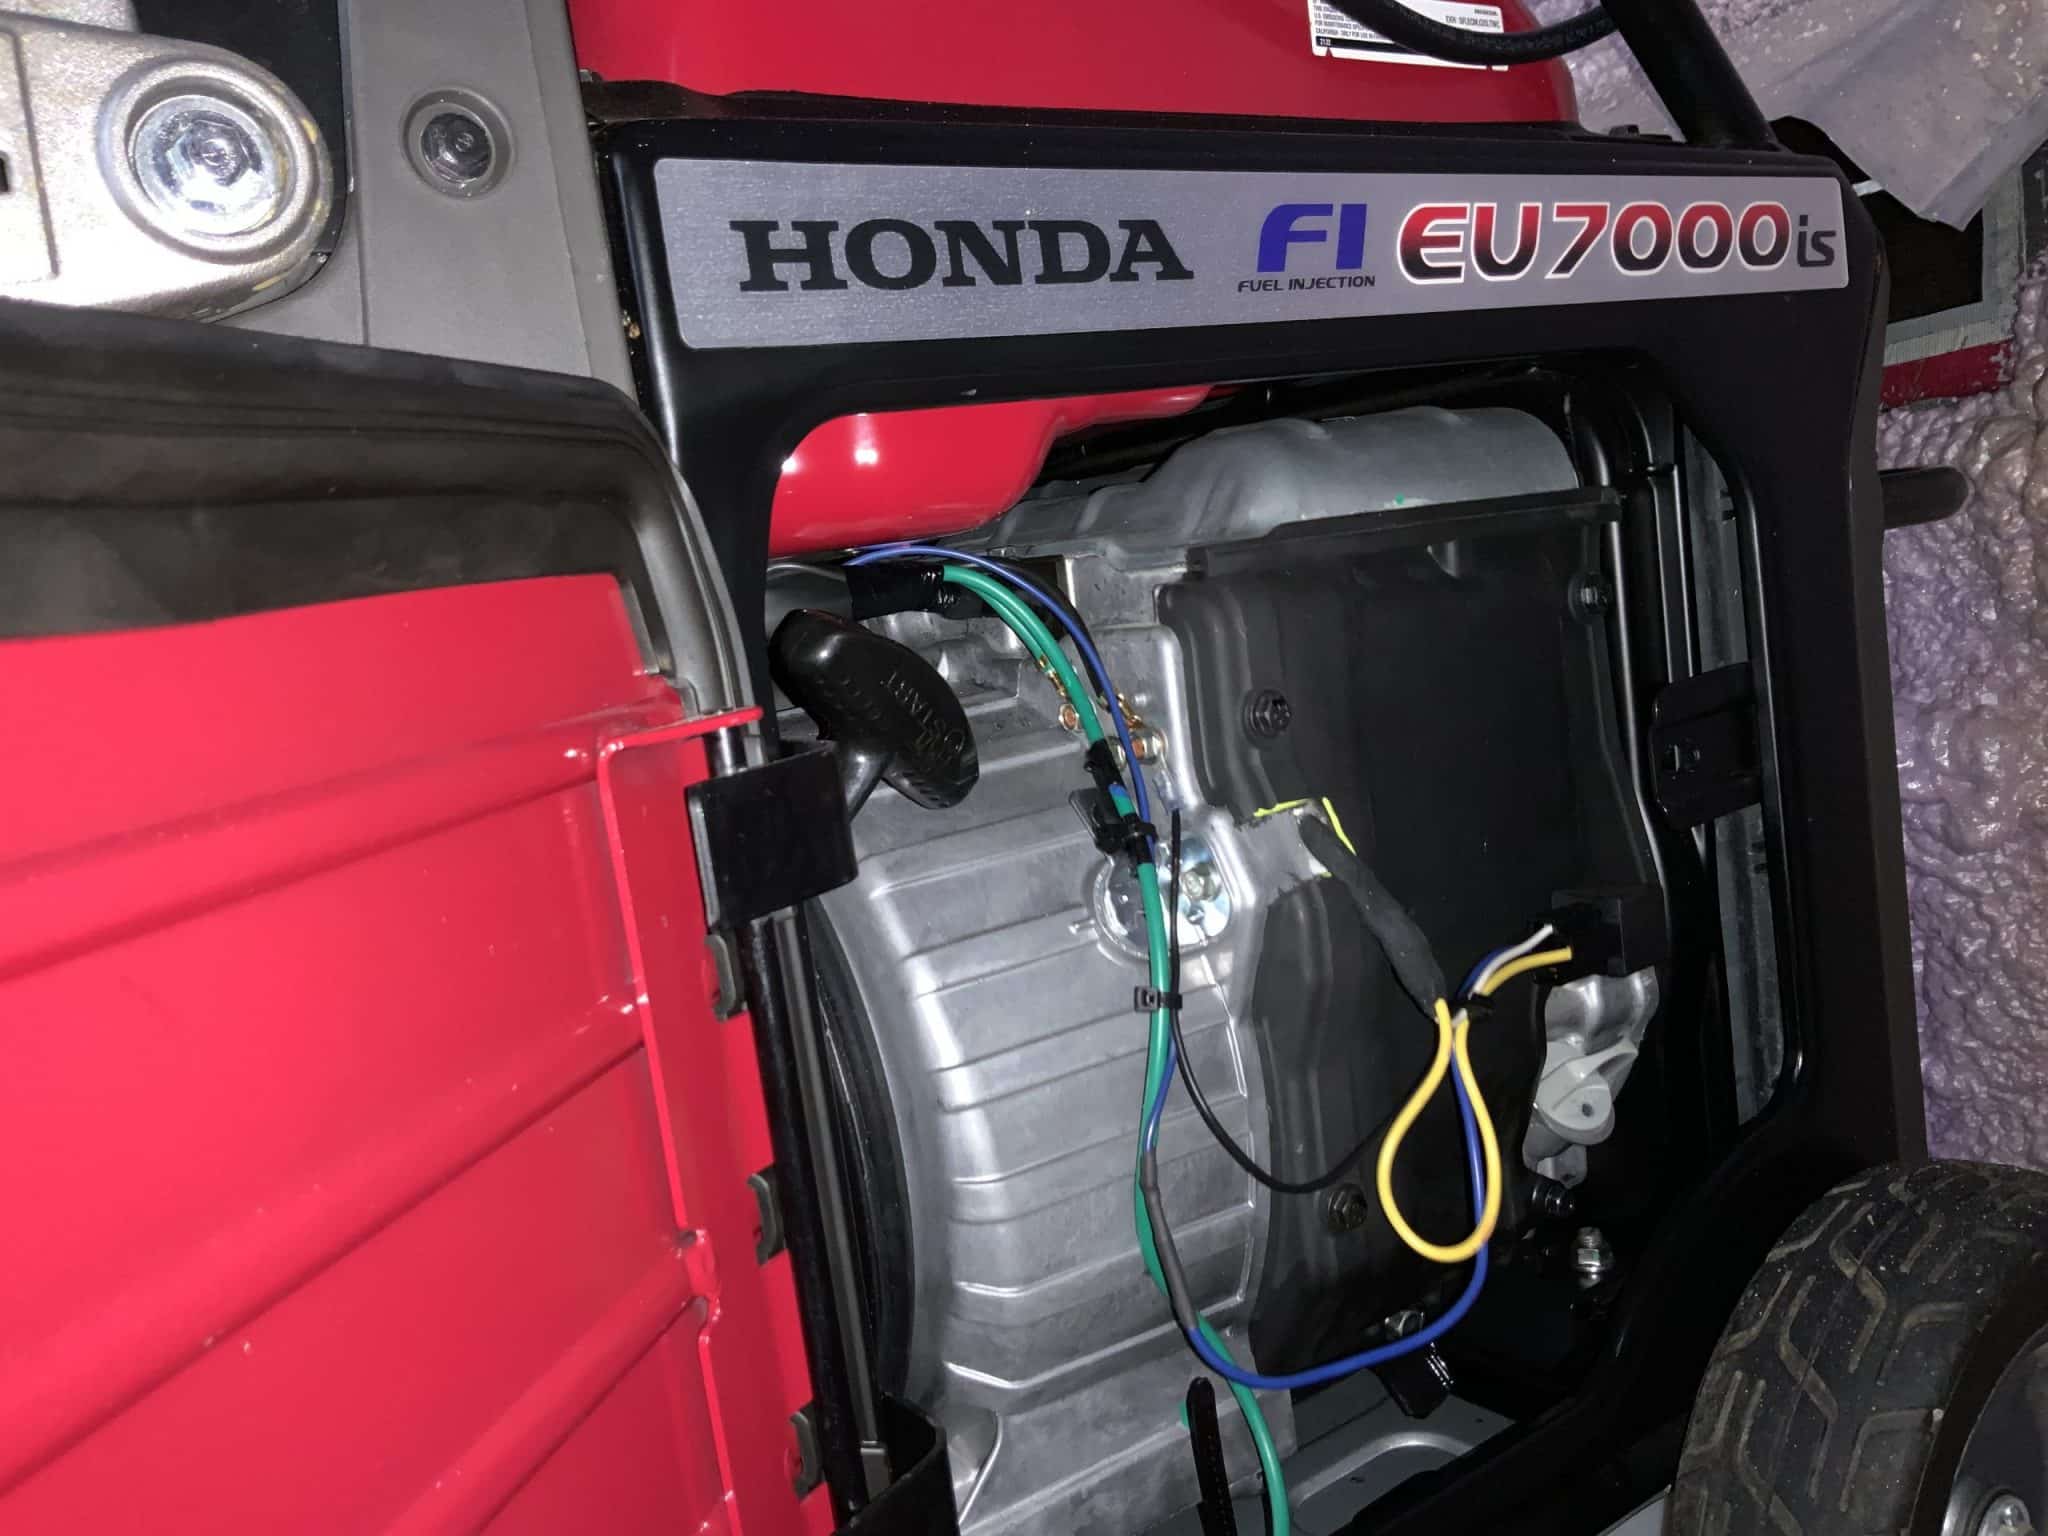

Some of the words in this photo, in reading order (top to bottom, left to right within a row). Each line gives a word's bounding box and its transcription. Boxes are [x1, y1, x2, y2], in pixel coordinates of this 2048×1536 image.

[730, 218, 1194, 292] HONDA
[1257, 203, 1368, 272] FI
[1397, 202, 1837, 285] EU7000is
[1237, 279, 1283, 293] FUEL
[1288, 275, 1376, 291] INJECTION
